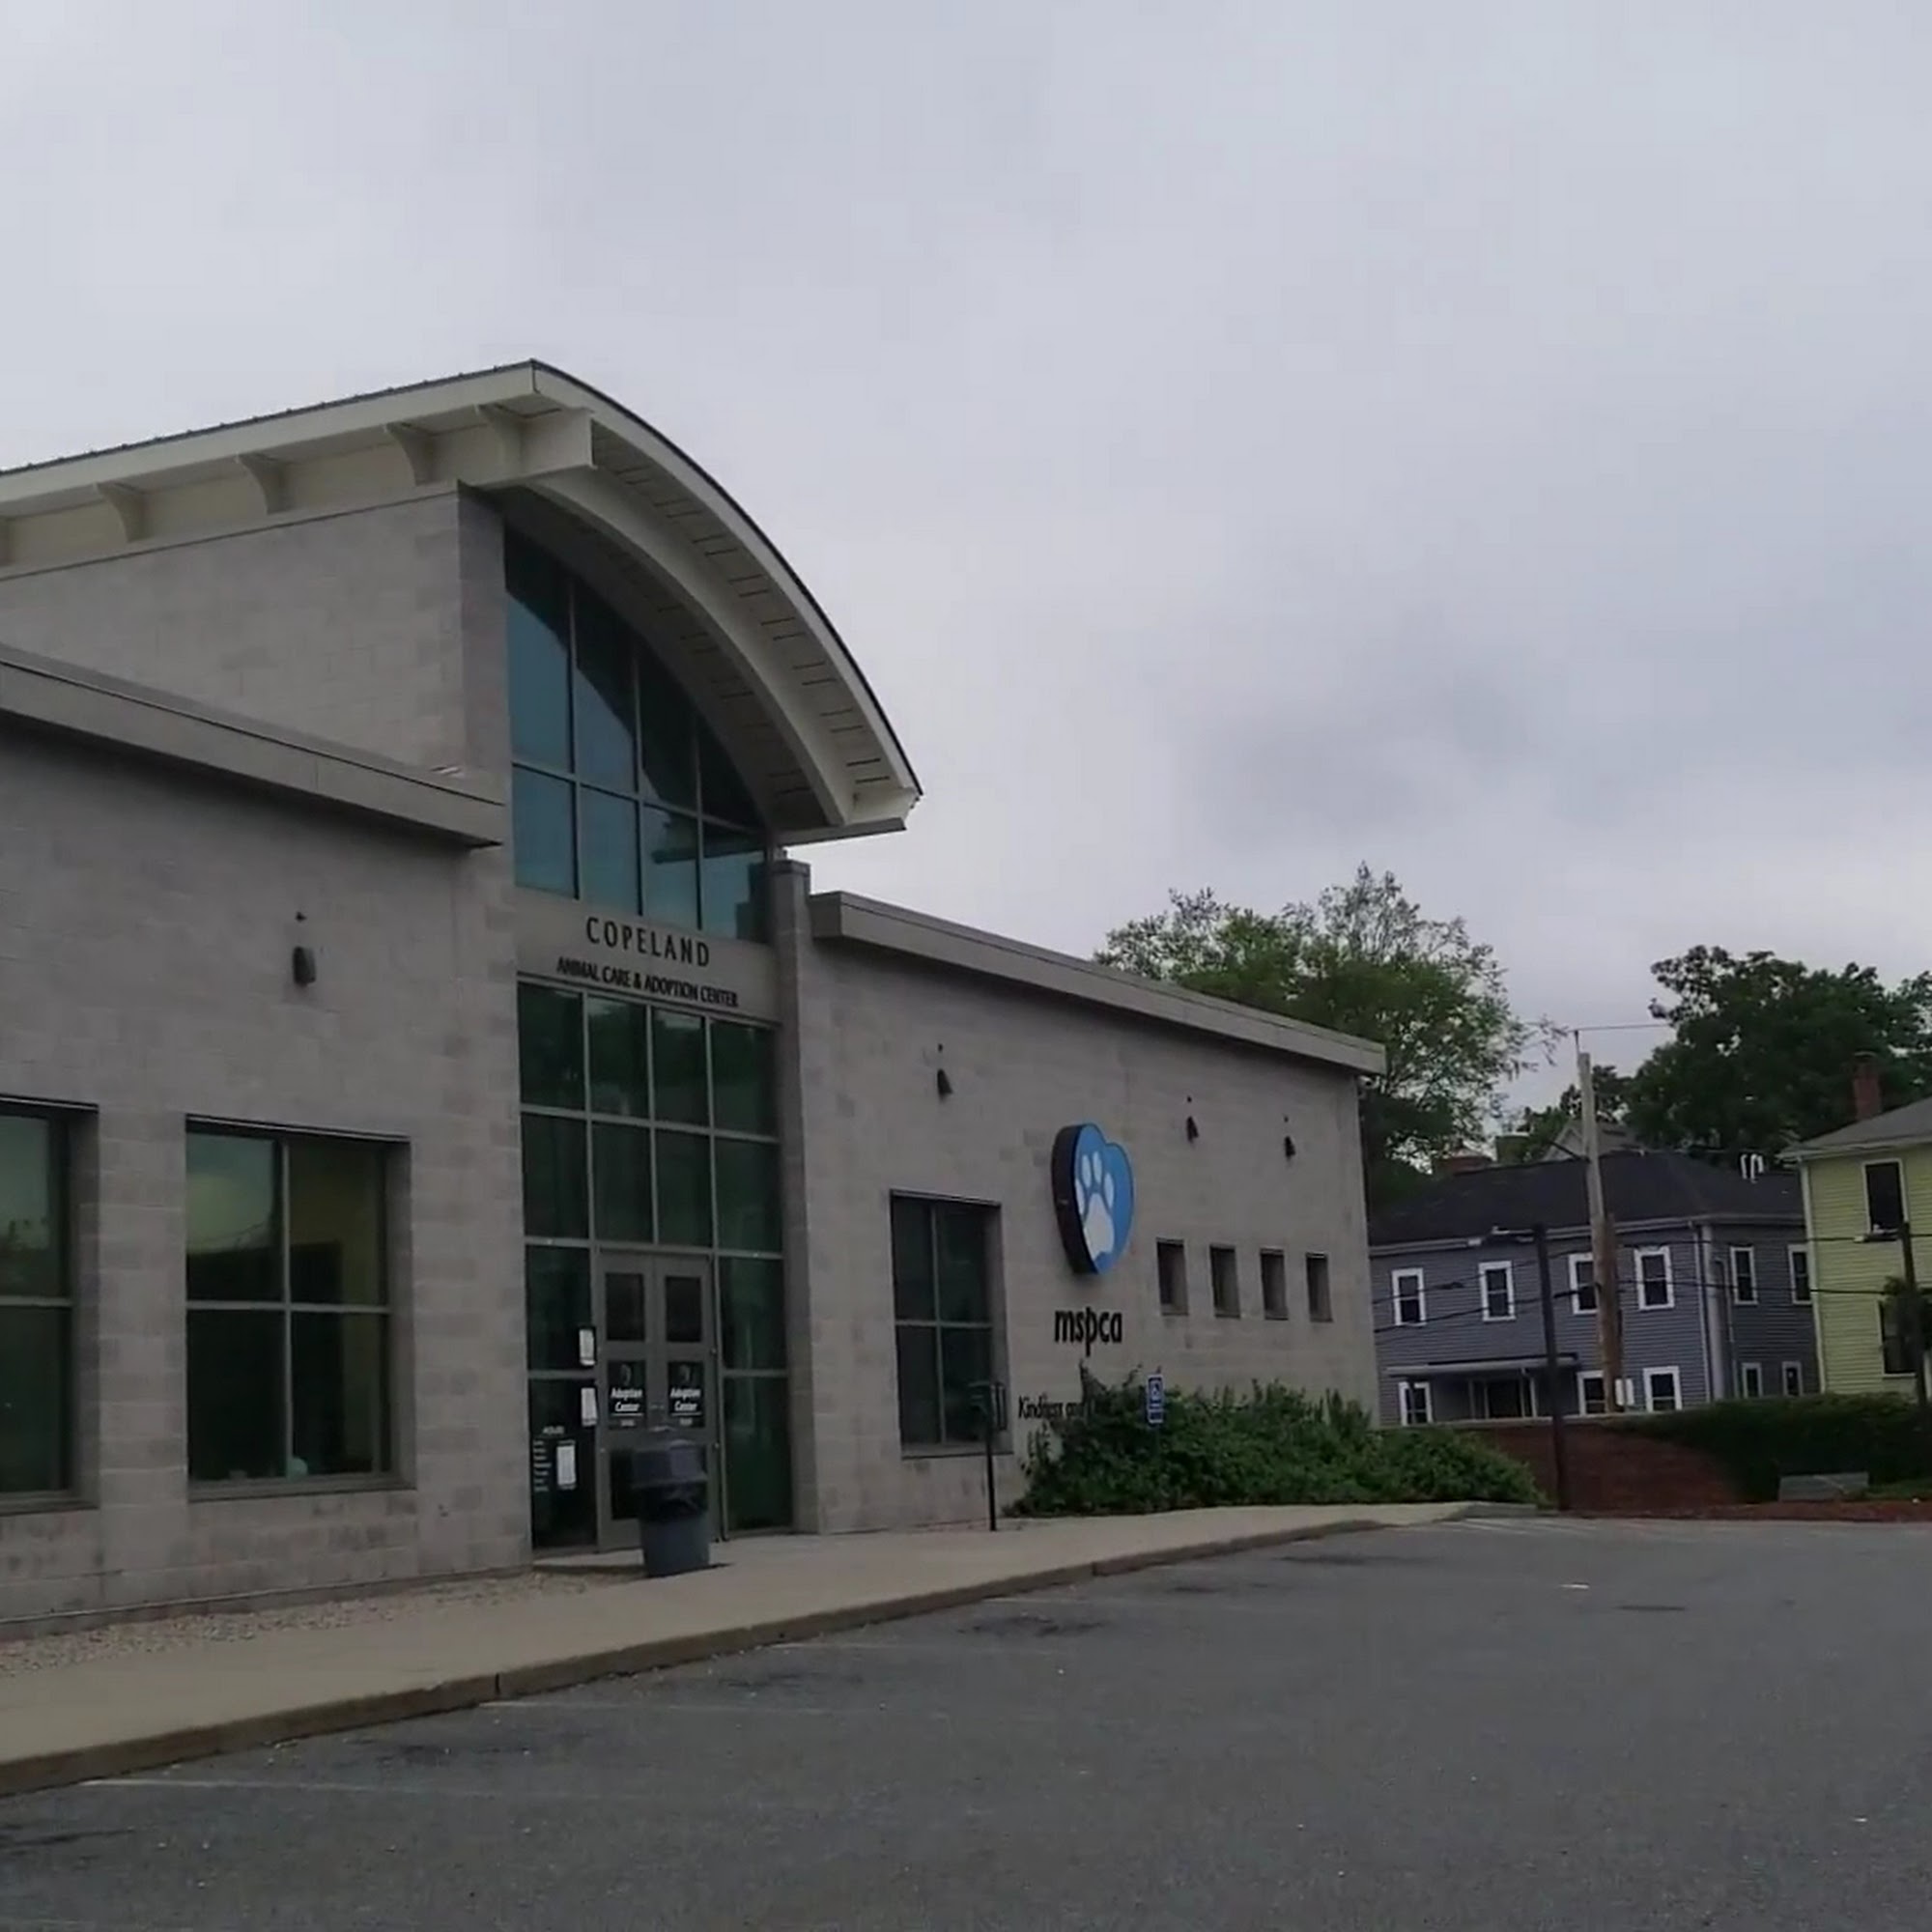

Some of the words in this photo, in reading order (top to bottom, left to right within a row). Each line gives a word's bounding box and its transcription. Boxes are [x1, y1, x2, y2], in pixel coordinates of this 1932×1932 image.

[585, 917, 710, 967] COPELAND
[556, 956, 600, 981] ANIMAL
[602, 966, 631, 987] CARE
[633, 973, 641, 989] &
[644, 975, 698, 1001] ADOPTION
[700, 985, 739, 1008] CENTER
[1054, 1307, 1122, 1357] mspca
